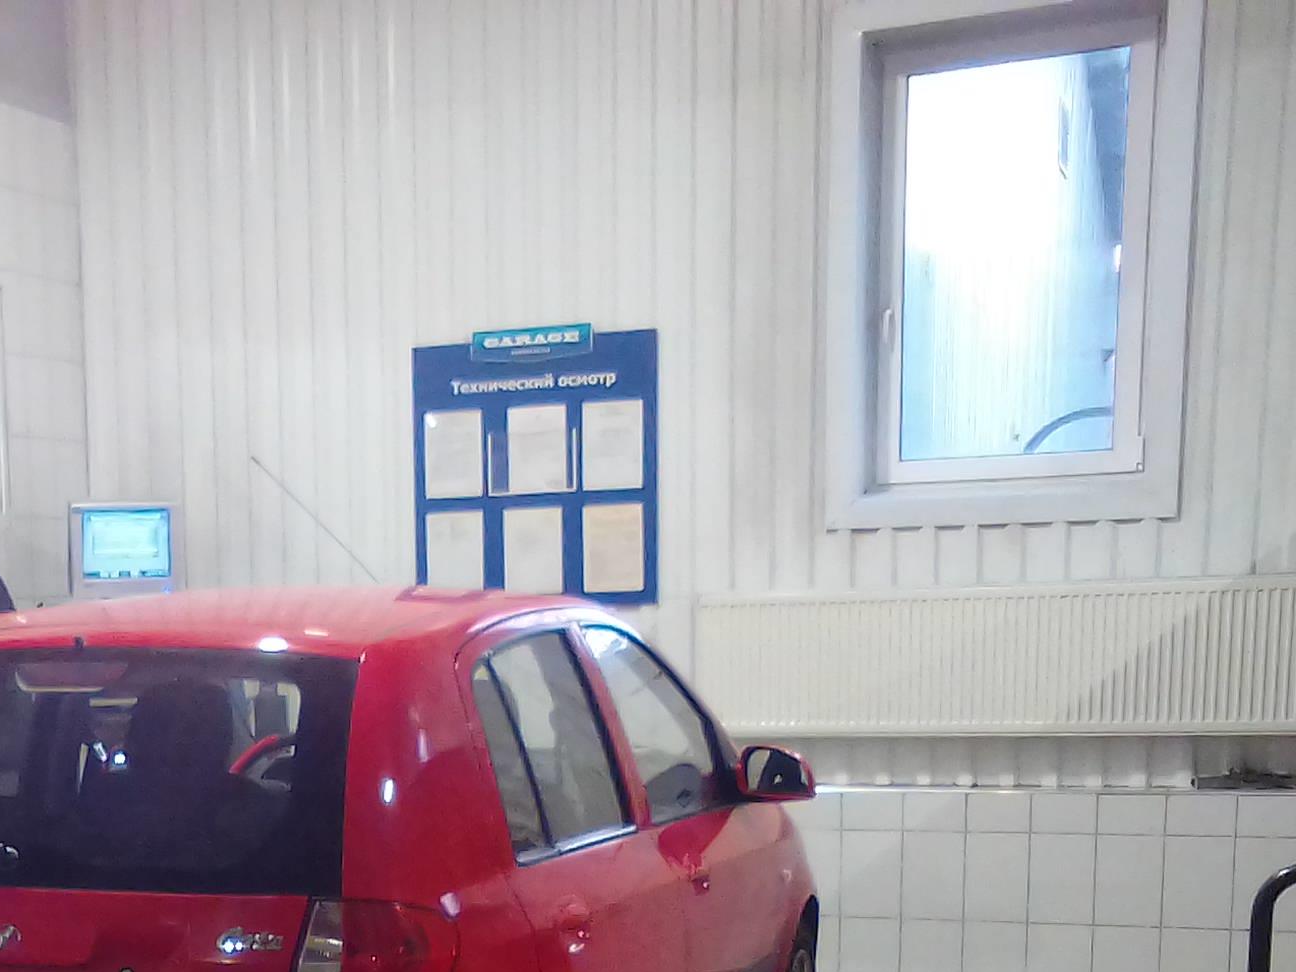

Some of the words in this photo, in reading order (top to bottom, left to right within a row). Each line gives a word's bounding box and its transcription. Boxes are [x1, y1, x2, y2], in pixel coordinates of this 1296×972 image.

[482, 331, 580, 349] GARAGE
[451, 374, 555, 396] Технический
[558, 372, 617, 390] осмотр
